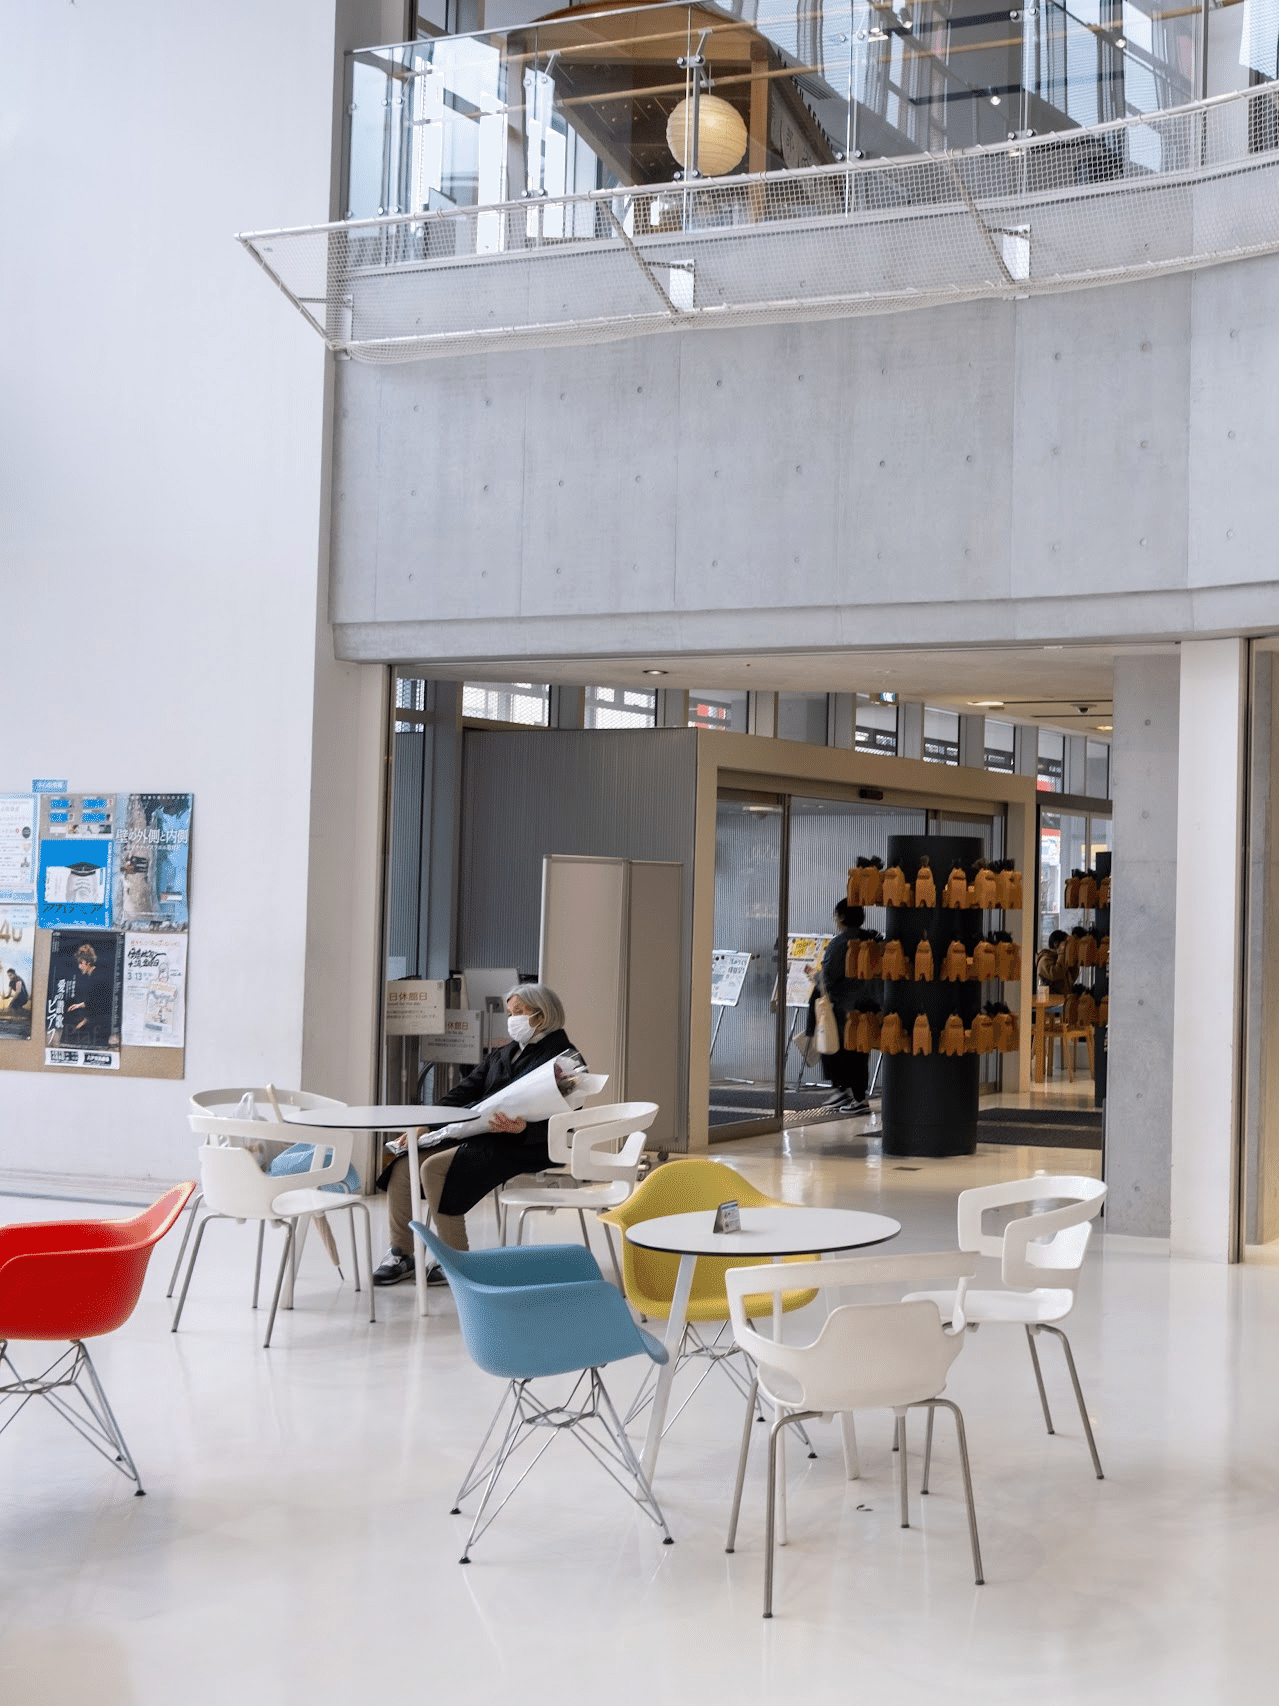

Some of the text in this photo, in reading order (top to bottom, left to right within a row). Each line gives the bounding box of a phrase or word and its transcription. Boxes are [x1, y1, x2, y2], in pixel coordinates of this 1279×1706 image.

[116, 828, 189, 844] 壁の外側と内側
[389, 992, 427, 1001] 日休館日
